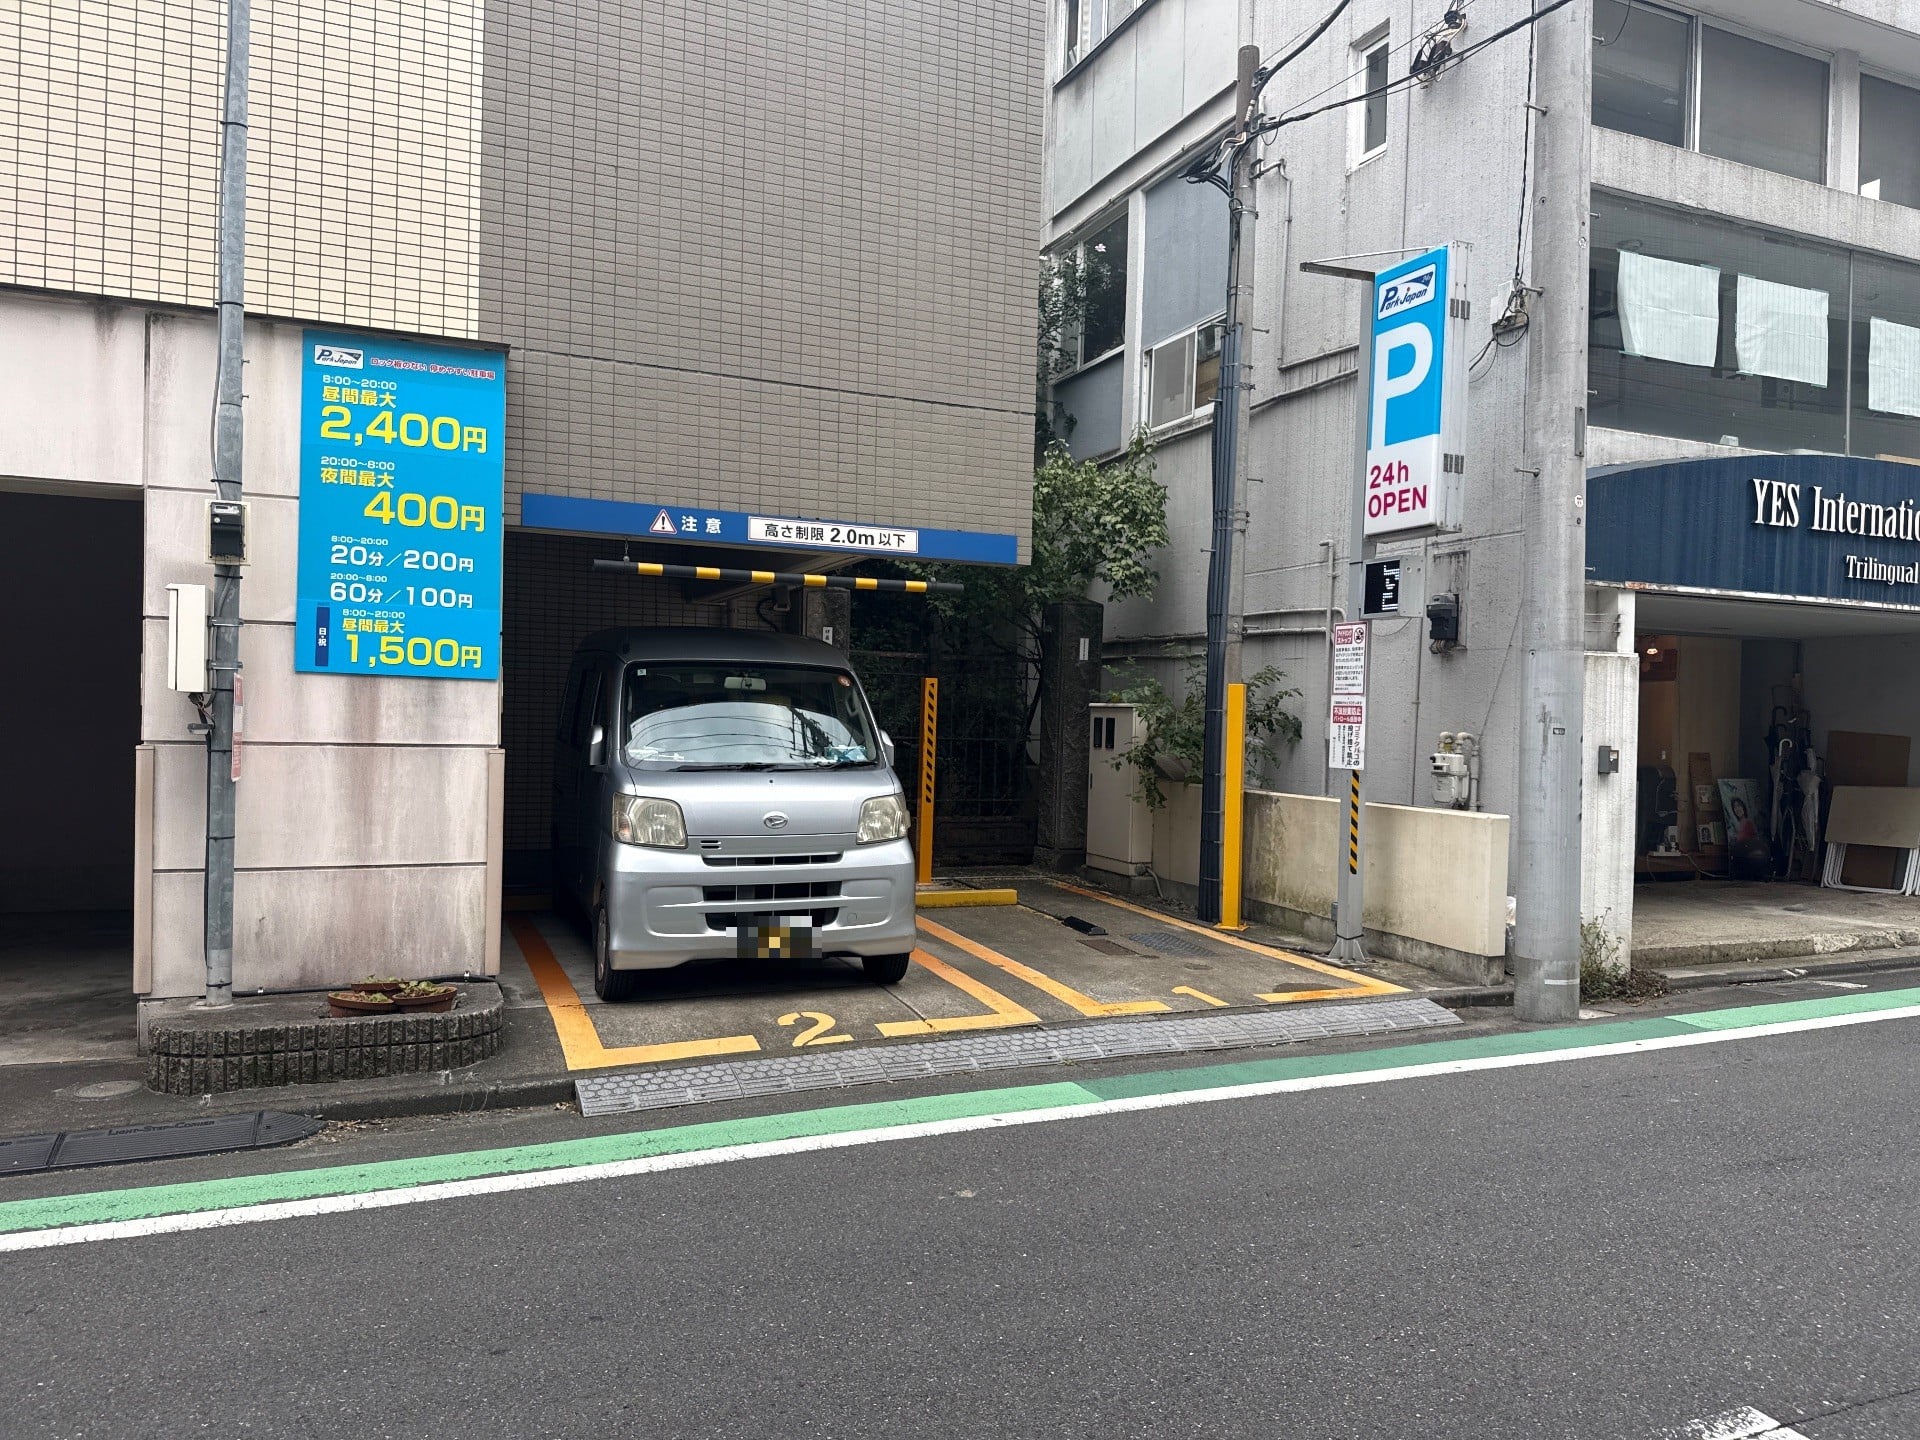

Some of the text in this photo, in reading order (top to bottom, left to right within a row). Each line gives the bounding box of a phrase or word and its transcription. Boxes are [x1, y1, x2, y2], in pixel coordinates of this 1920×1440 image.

[1380, 286, 1427, 312] Park Japan
[316, 349, 334, 362] Park
[335, 354, 357, 365] Japan
[322, 386, 397, 408] 昼間最大
[1371, 321, 1433, 451] P
[320, 405, 488, 454] 2,400円
[320, 467, 395, 488] 夜間最大
[1369, 460, 1409, 489] 24h
[364, 490, 485, 532] 400円
[1368, 484, 1428, 518] OPEN
[1752, 478, 1800, 528] YES
[681, 515, 722, 535] 注意
[764, 522, 906, 549] 高さ制限 2.0m 以下
[1846, 555, 1919, 586] Trilingual
[342, 618, 405, 634] 昼間最大
[346, 633, 482, 669] 1,500円
[1171, 985, 1230, 1006] 1
[777, 1011, 854, 1047] 2
